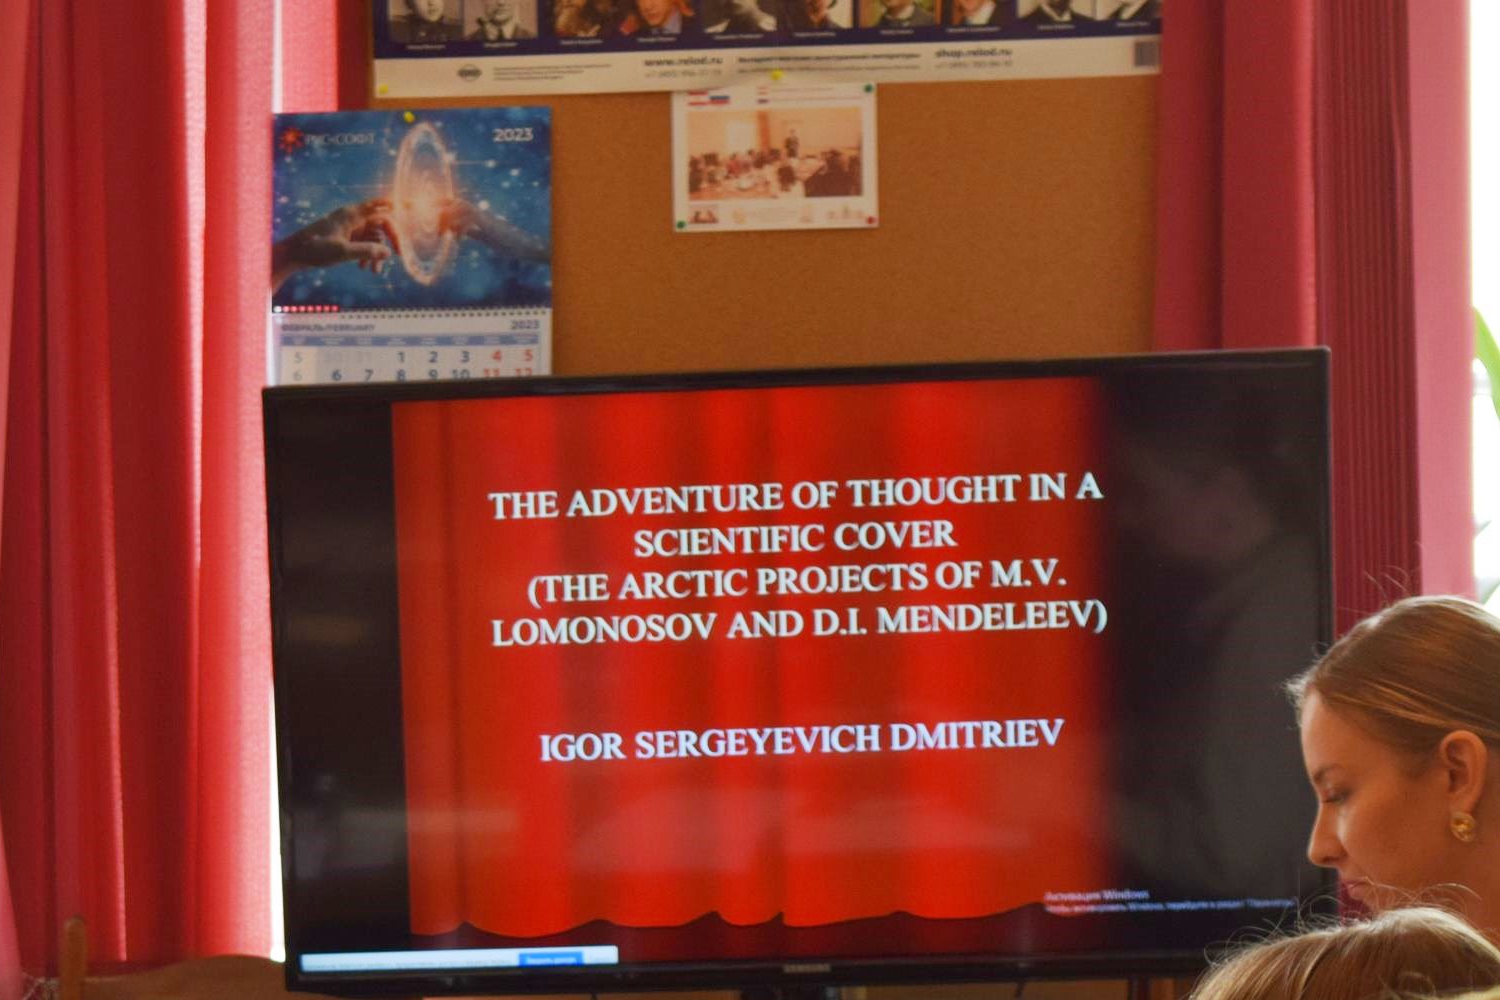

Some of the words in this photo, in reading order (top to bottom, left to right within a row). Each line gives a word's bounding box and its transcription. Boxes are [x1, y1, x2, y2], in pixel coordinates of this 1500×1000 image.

[493, 127, 534, 143] 2023
[510, 319, 541, 331] 2023
[332, 370, 342, 382] 6
[364, 370, 374, 382] 7
[396, 370, 406, 381] 8
[428, 370, 439, 381] 9
[451, 369, 471, 380] 10
[397, 351, 405, 363] 1
[428, 351, 439, 363] 2
[460, 351, 471, 363] 3
[491, 350, 503, 362] 4
[524, 350, 534, 362] 5
[488, 490, 560, 520] THE
[565, 482, 785, 518] ADVENTURE
[791, 480, 839, 510] OF
[846, 474, 1022, 508] THOUGHT
[1028, 472, 1067, 502] IN
[1075, 471, 1104, 500] A
[633, 523, 826, 558] SCIENTIFIC
[833, 519, 958, 551] COVER
[527, 573, 611, 610] (THE
[617, 567, 749, 601] ARCTIC
[756, 561, 928, 596] PROJECTS
[934, 560, 983, 590] OF
[989, 558, 1068, 588] M.V.
[491, 612, 718, 647] LOMONOSOV
[726, 609, 805, 640] AND
[813, 607, 868, 637] D.I.
[876, 599, 1109, 635] MENDELEEV)
[539, 732, 627, 762] IGOR
[634, 724, 882, 760] SERGEYEVICH
[889, 718, 1066, 752] DMITRIEV
